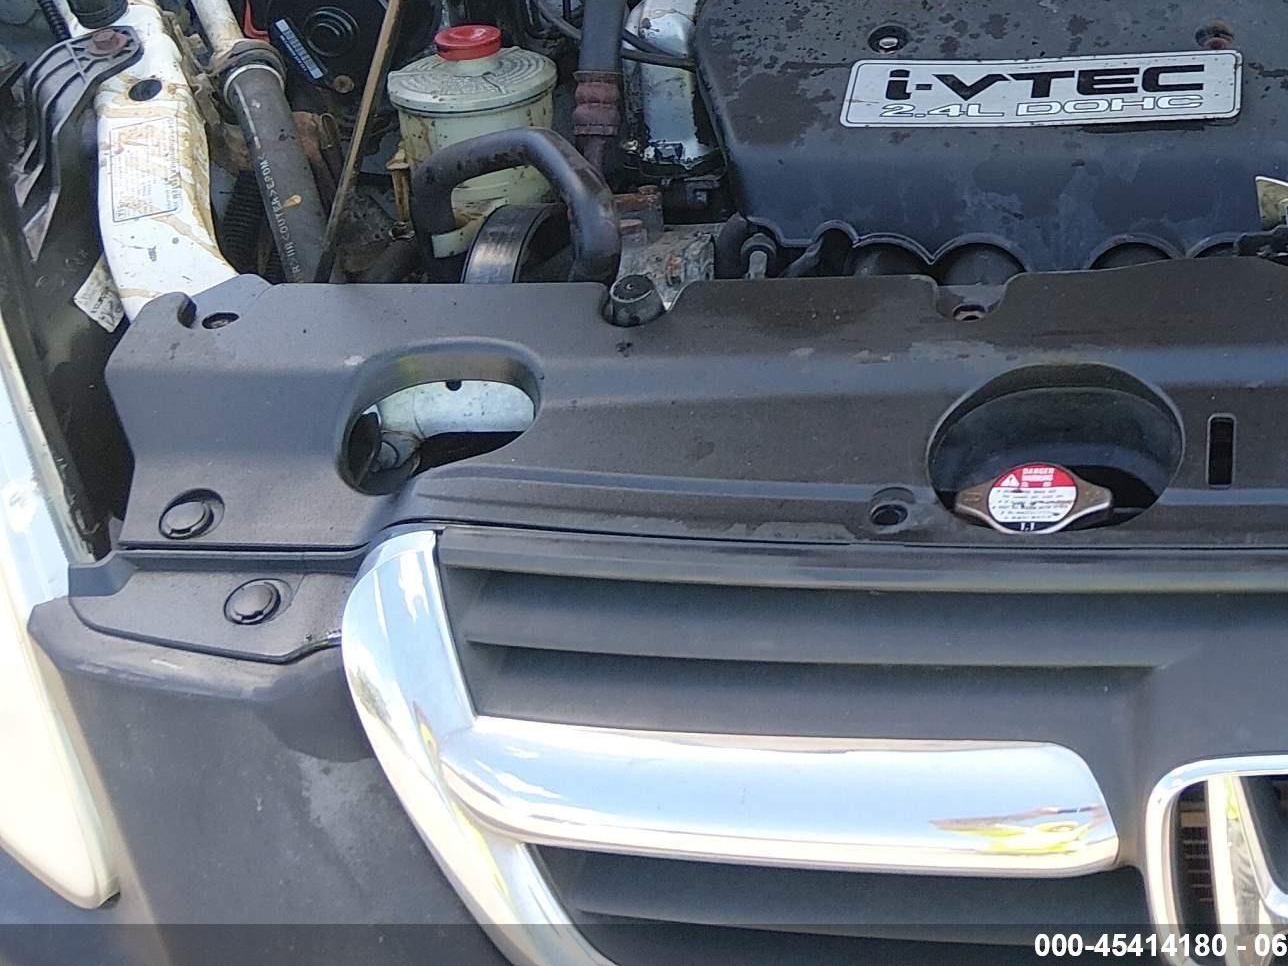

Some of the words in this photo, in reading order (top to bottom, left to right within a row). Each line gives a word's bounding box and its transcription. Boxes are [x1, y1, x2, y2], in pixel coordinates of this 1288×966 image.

[885, 65, 1205, 101] i-VTEC
[879, 103, 1005, 118] 2.4L
[1015, 95, 1204, 117] DOHC
